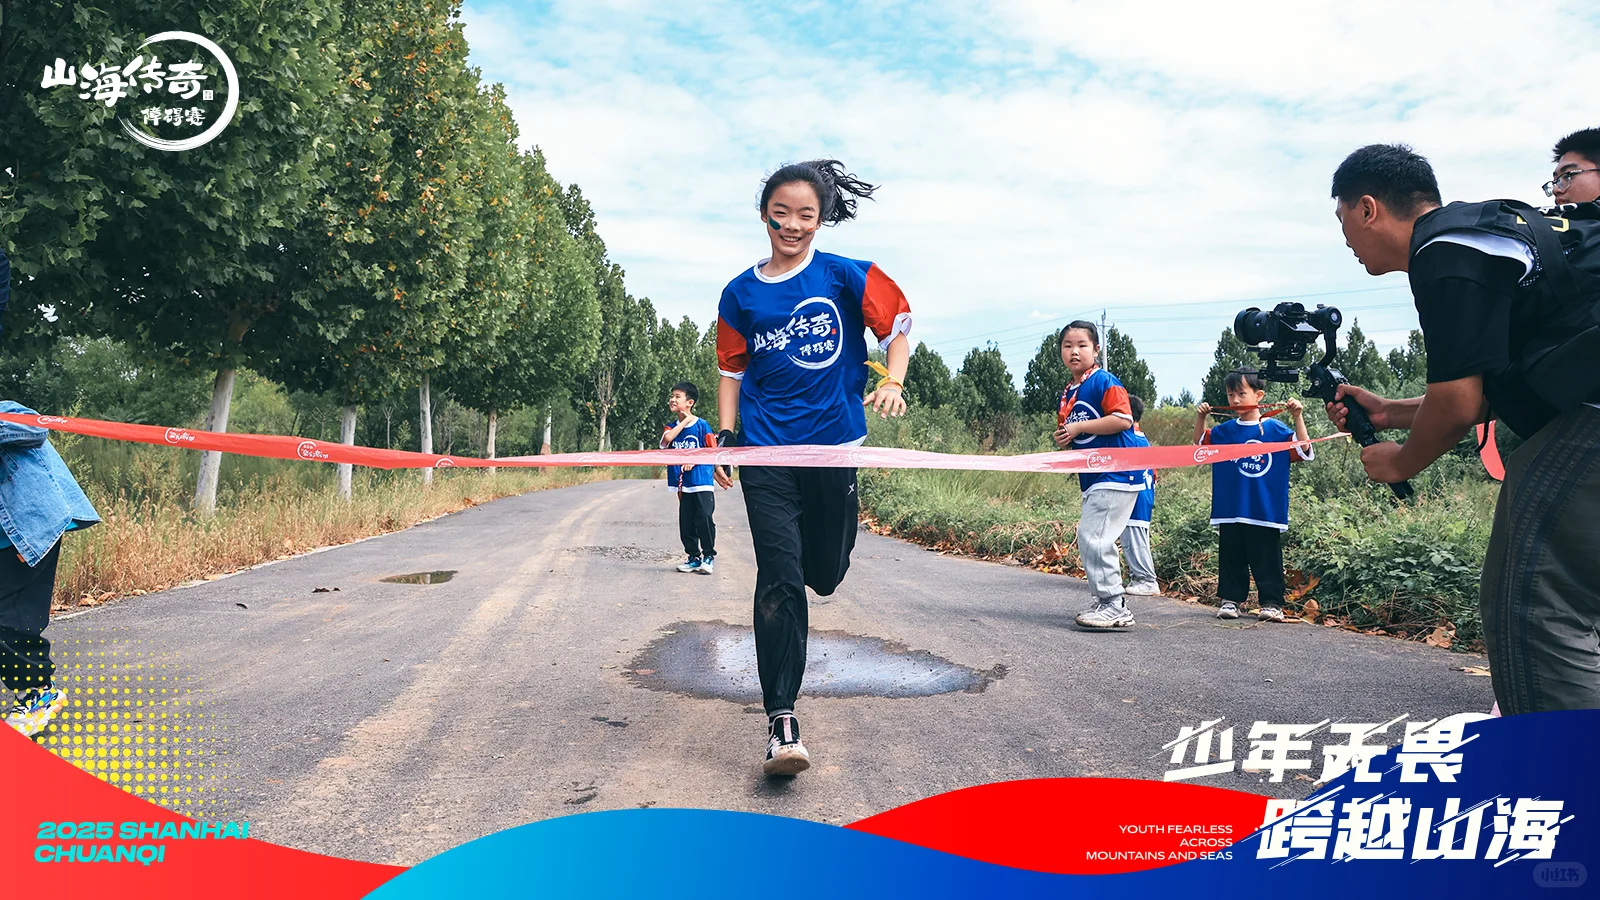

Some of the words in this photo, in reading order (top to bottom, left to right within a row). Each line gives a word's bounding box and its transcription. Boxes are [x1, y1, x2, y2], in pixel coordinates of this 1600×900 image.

[754, 312, 833, 352] 山海传奇
[799, 339, 835, 356] 障碍赛
